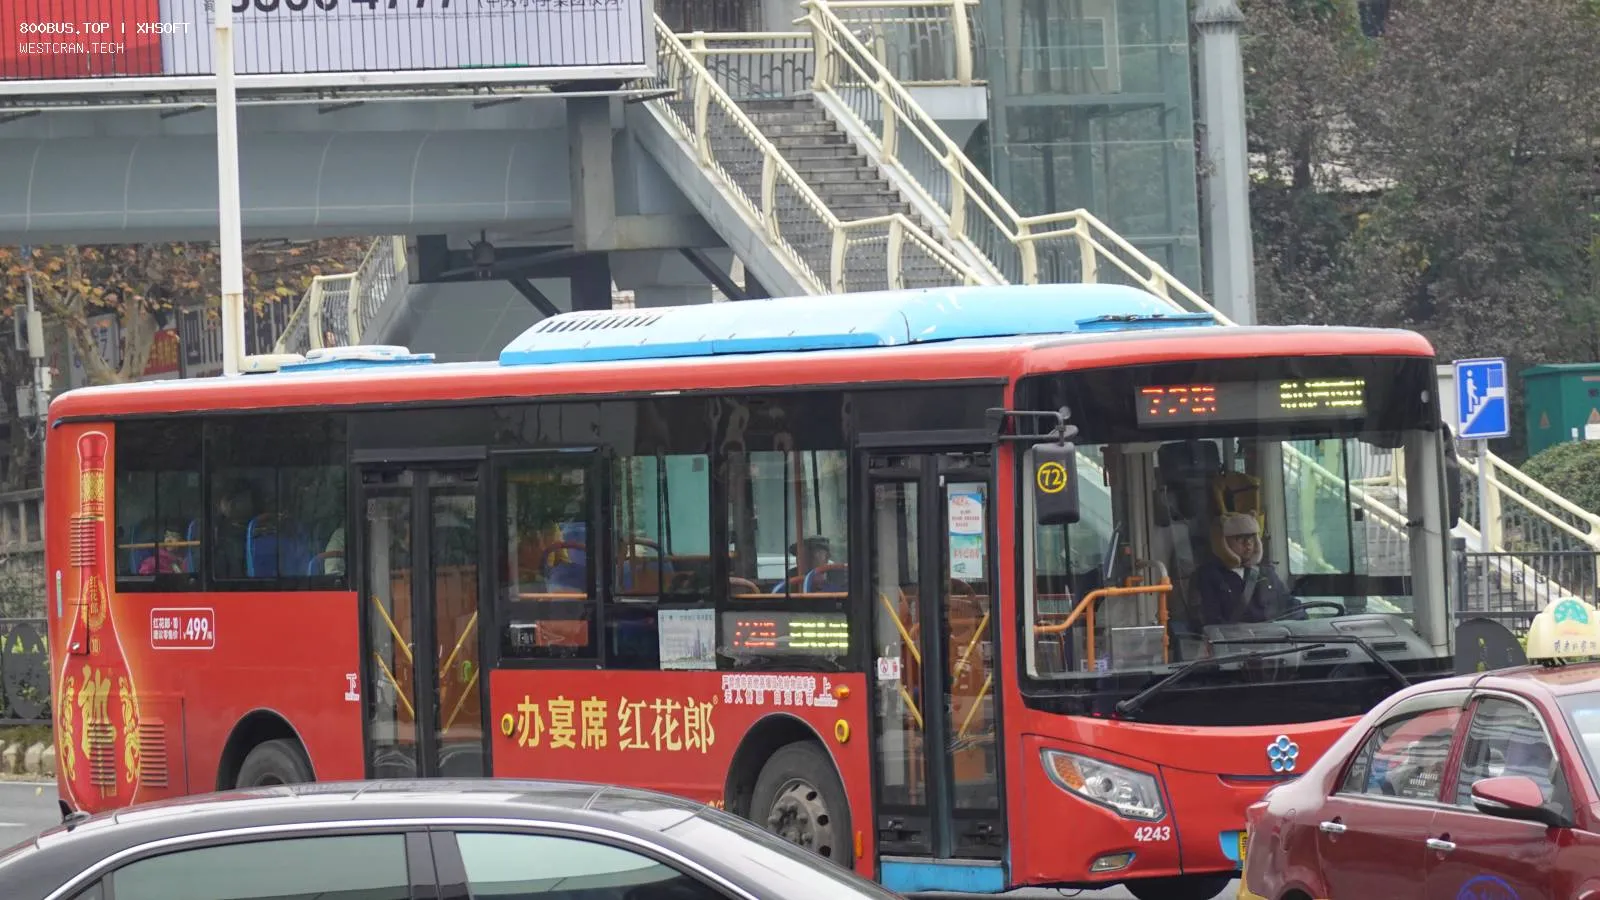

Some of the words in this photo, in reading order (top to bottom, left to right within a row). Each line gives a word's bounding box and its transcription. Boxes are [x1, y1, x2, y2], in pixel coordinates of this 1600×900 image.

[1041, 468, 1062, 487] 72
[517, 695, 608, 750] 办宴席
[617, 696, 715, 754] 红花郎
[1134, 826, 1170, 841] 4243
